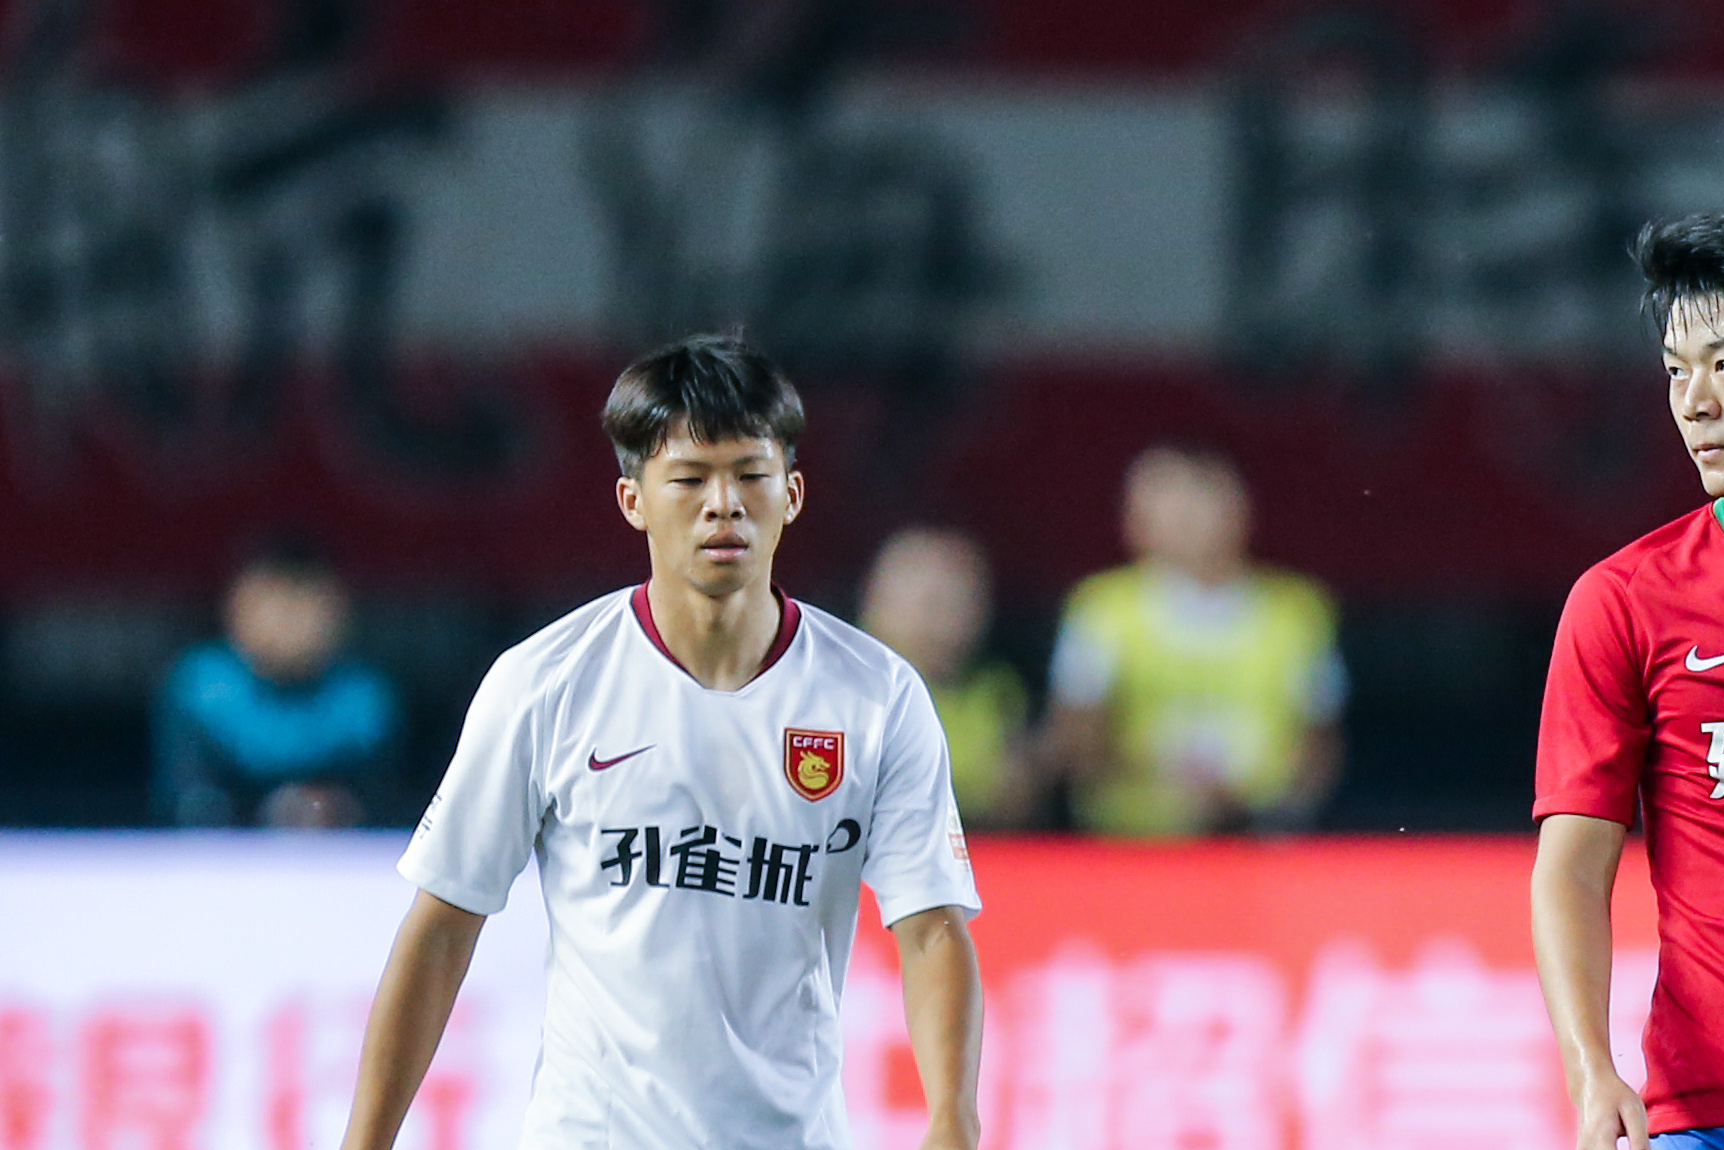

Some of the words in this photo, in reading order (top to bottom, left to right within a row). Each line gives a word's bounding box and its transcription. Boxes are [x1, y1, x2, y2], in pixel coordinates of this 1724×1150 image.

[792, 735, 835, 750] CFFC
[600, 824, 820, 906] 孔雀城
